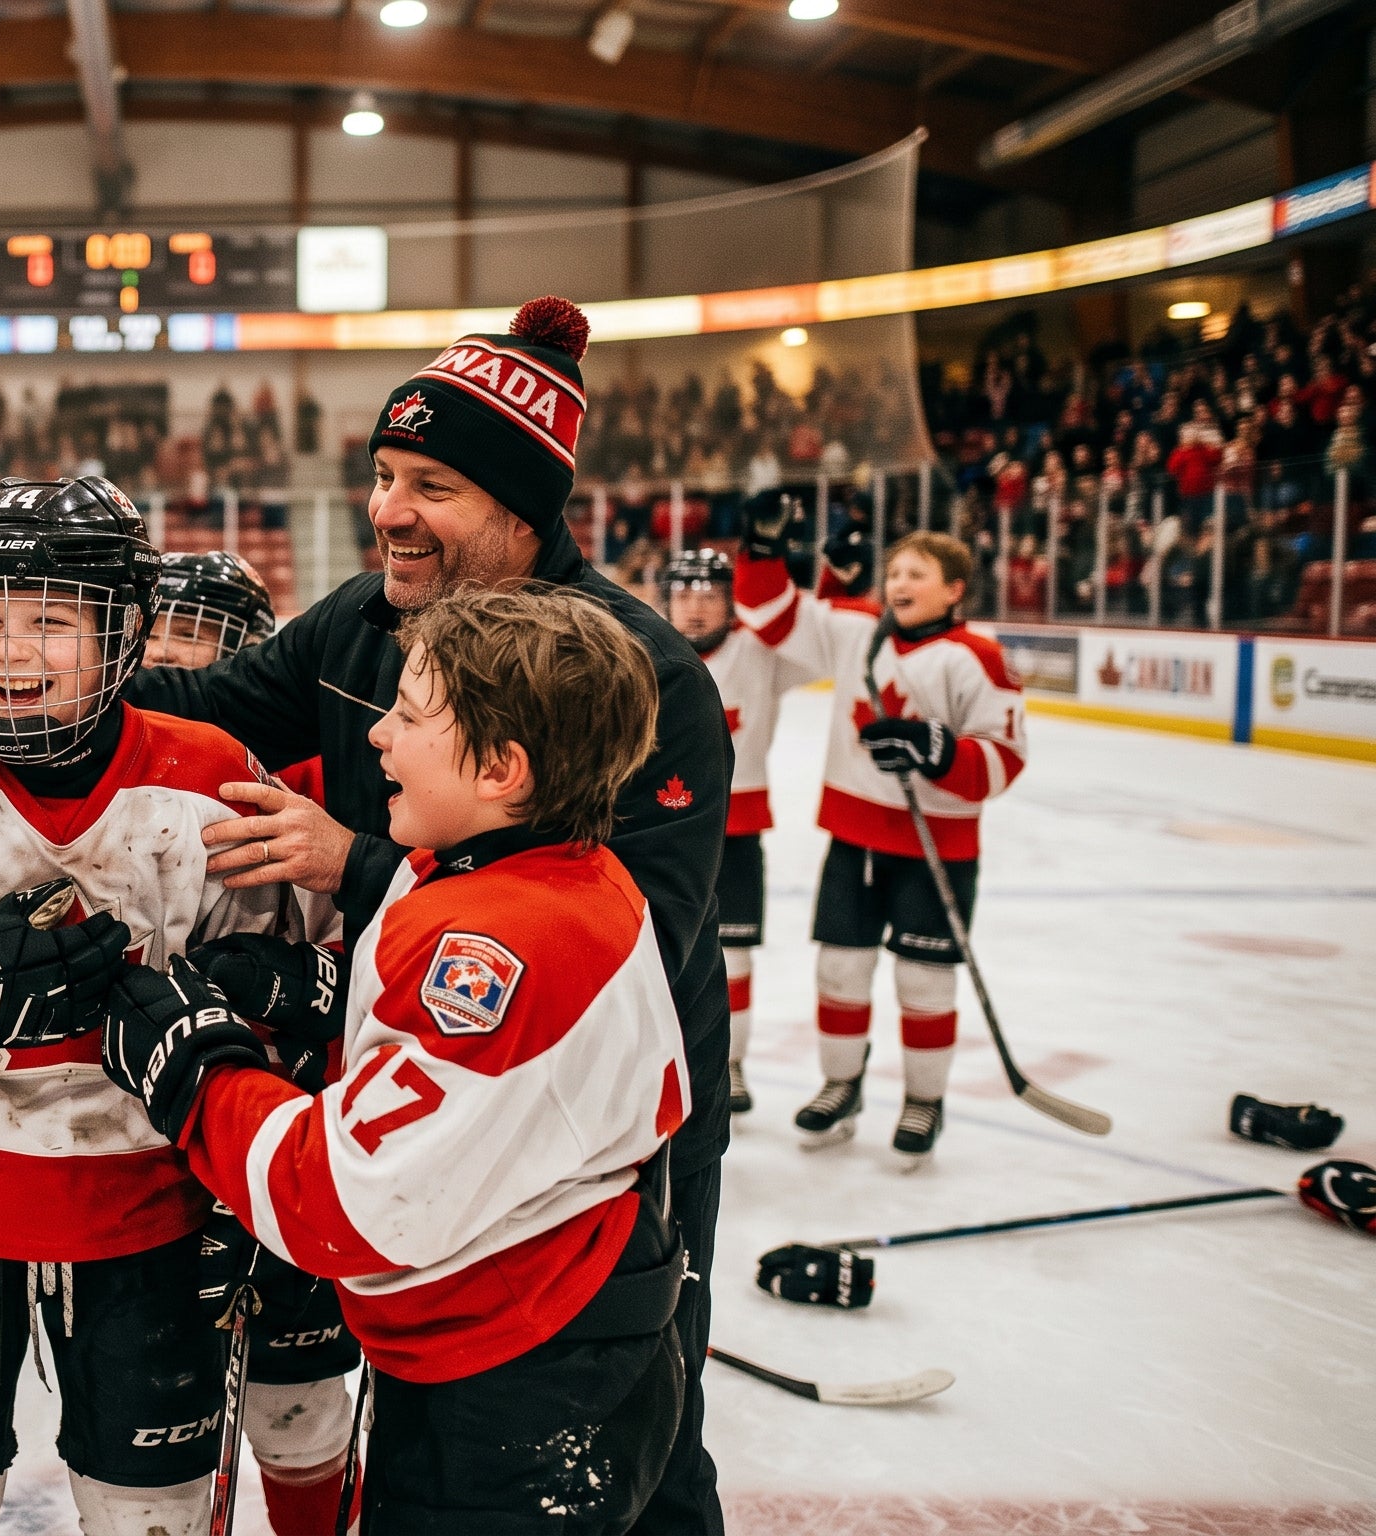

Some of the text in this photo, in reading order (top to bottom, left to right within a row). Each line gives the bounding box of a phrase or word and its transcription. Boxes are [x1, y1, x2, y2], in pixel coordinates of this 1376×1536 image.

[142, 1006, 252, 1108] AUER
[341, 1044, 446, 1156] 17
[268, 1323, 342, 1348] CCM
[131, 1409, 221, 1447] CCM
